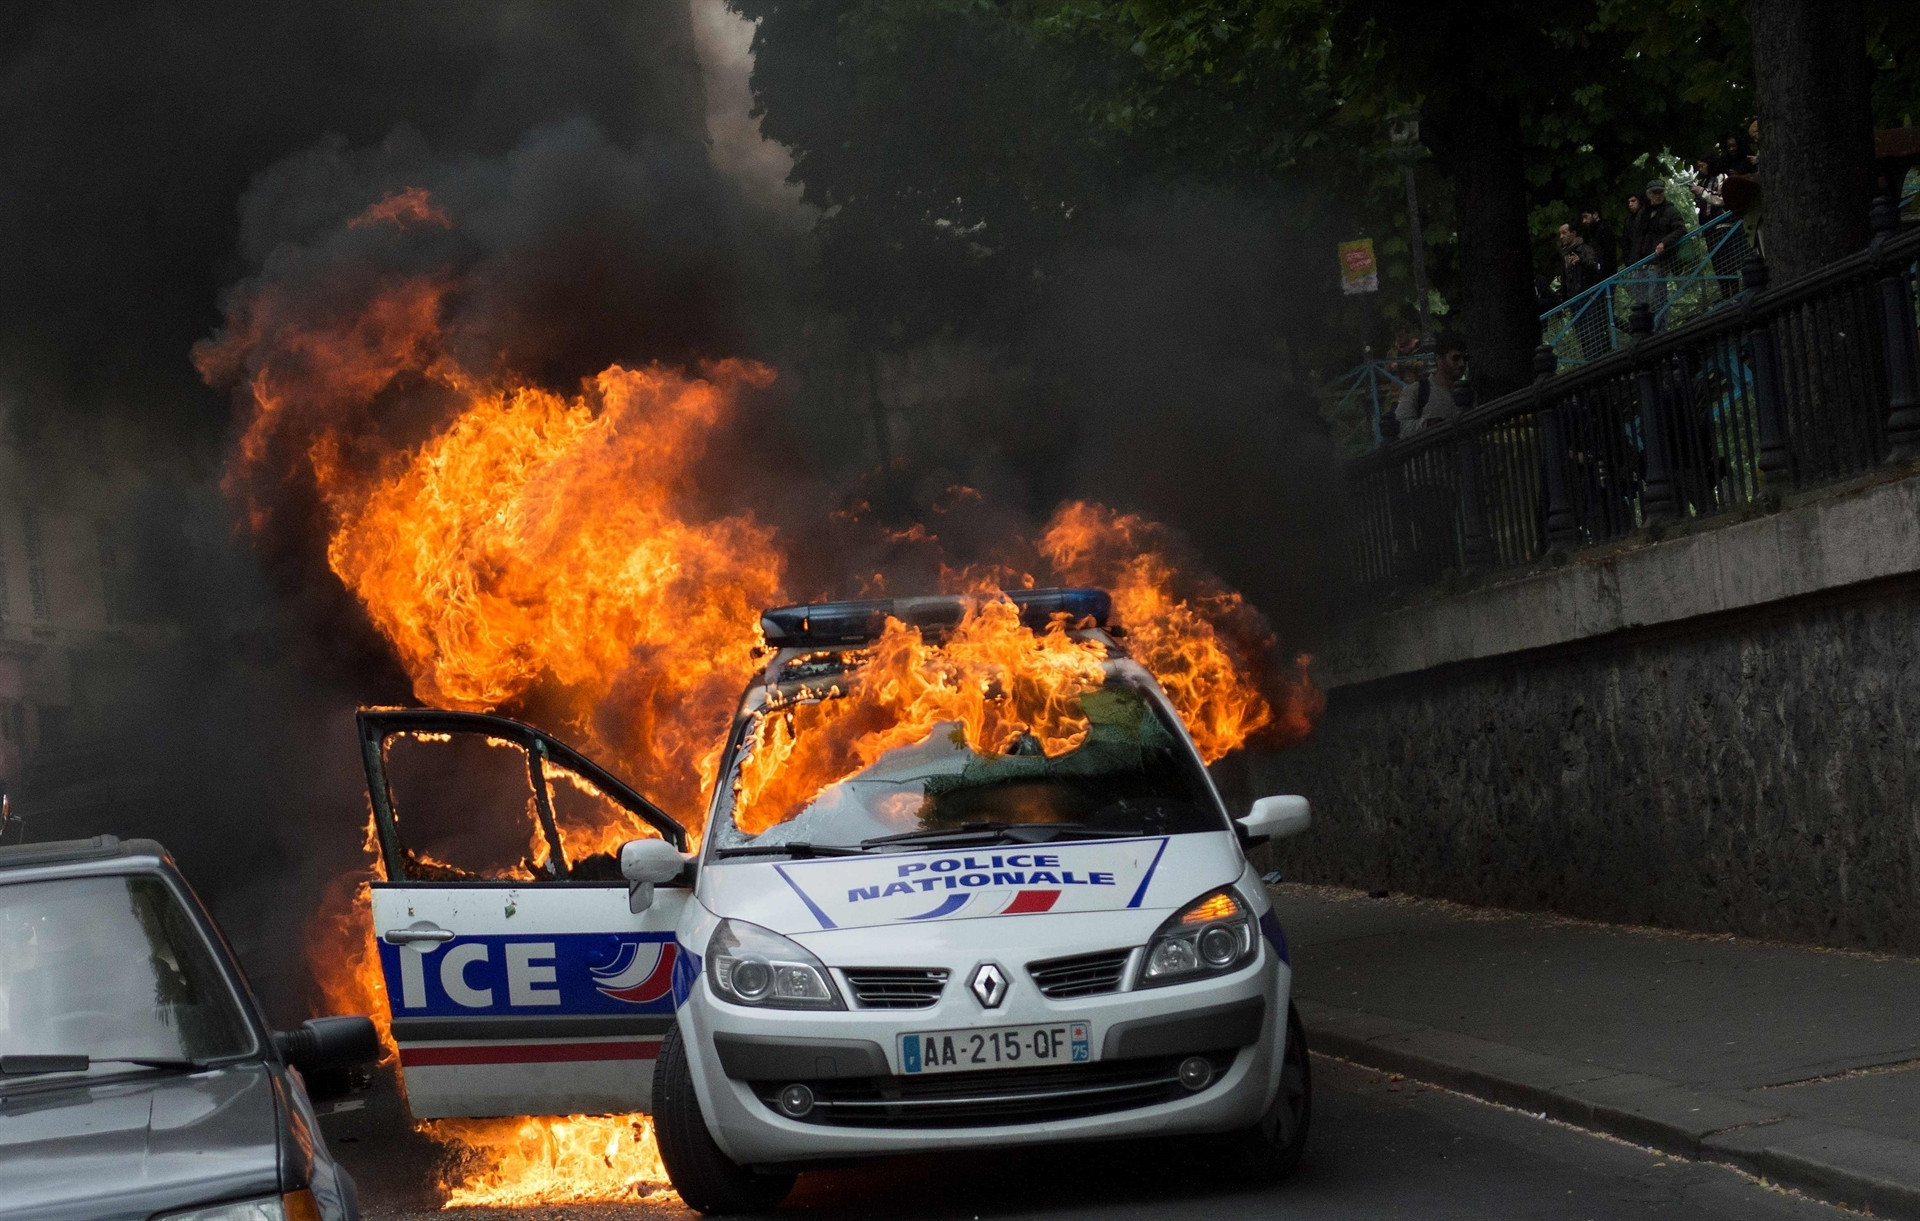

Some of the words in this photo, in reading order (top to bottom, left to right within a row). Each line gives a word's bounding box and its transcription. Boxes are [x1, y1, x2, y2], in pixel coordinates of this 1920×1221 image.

[897, 854, 1061, 877] POLICE
[848, 871, 1116, 902] NATIONALE
[924, 1029, 1066, 1067] AA-215-QF
[1073, 1044, 1088, 1059] 75
